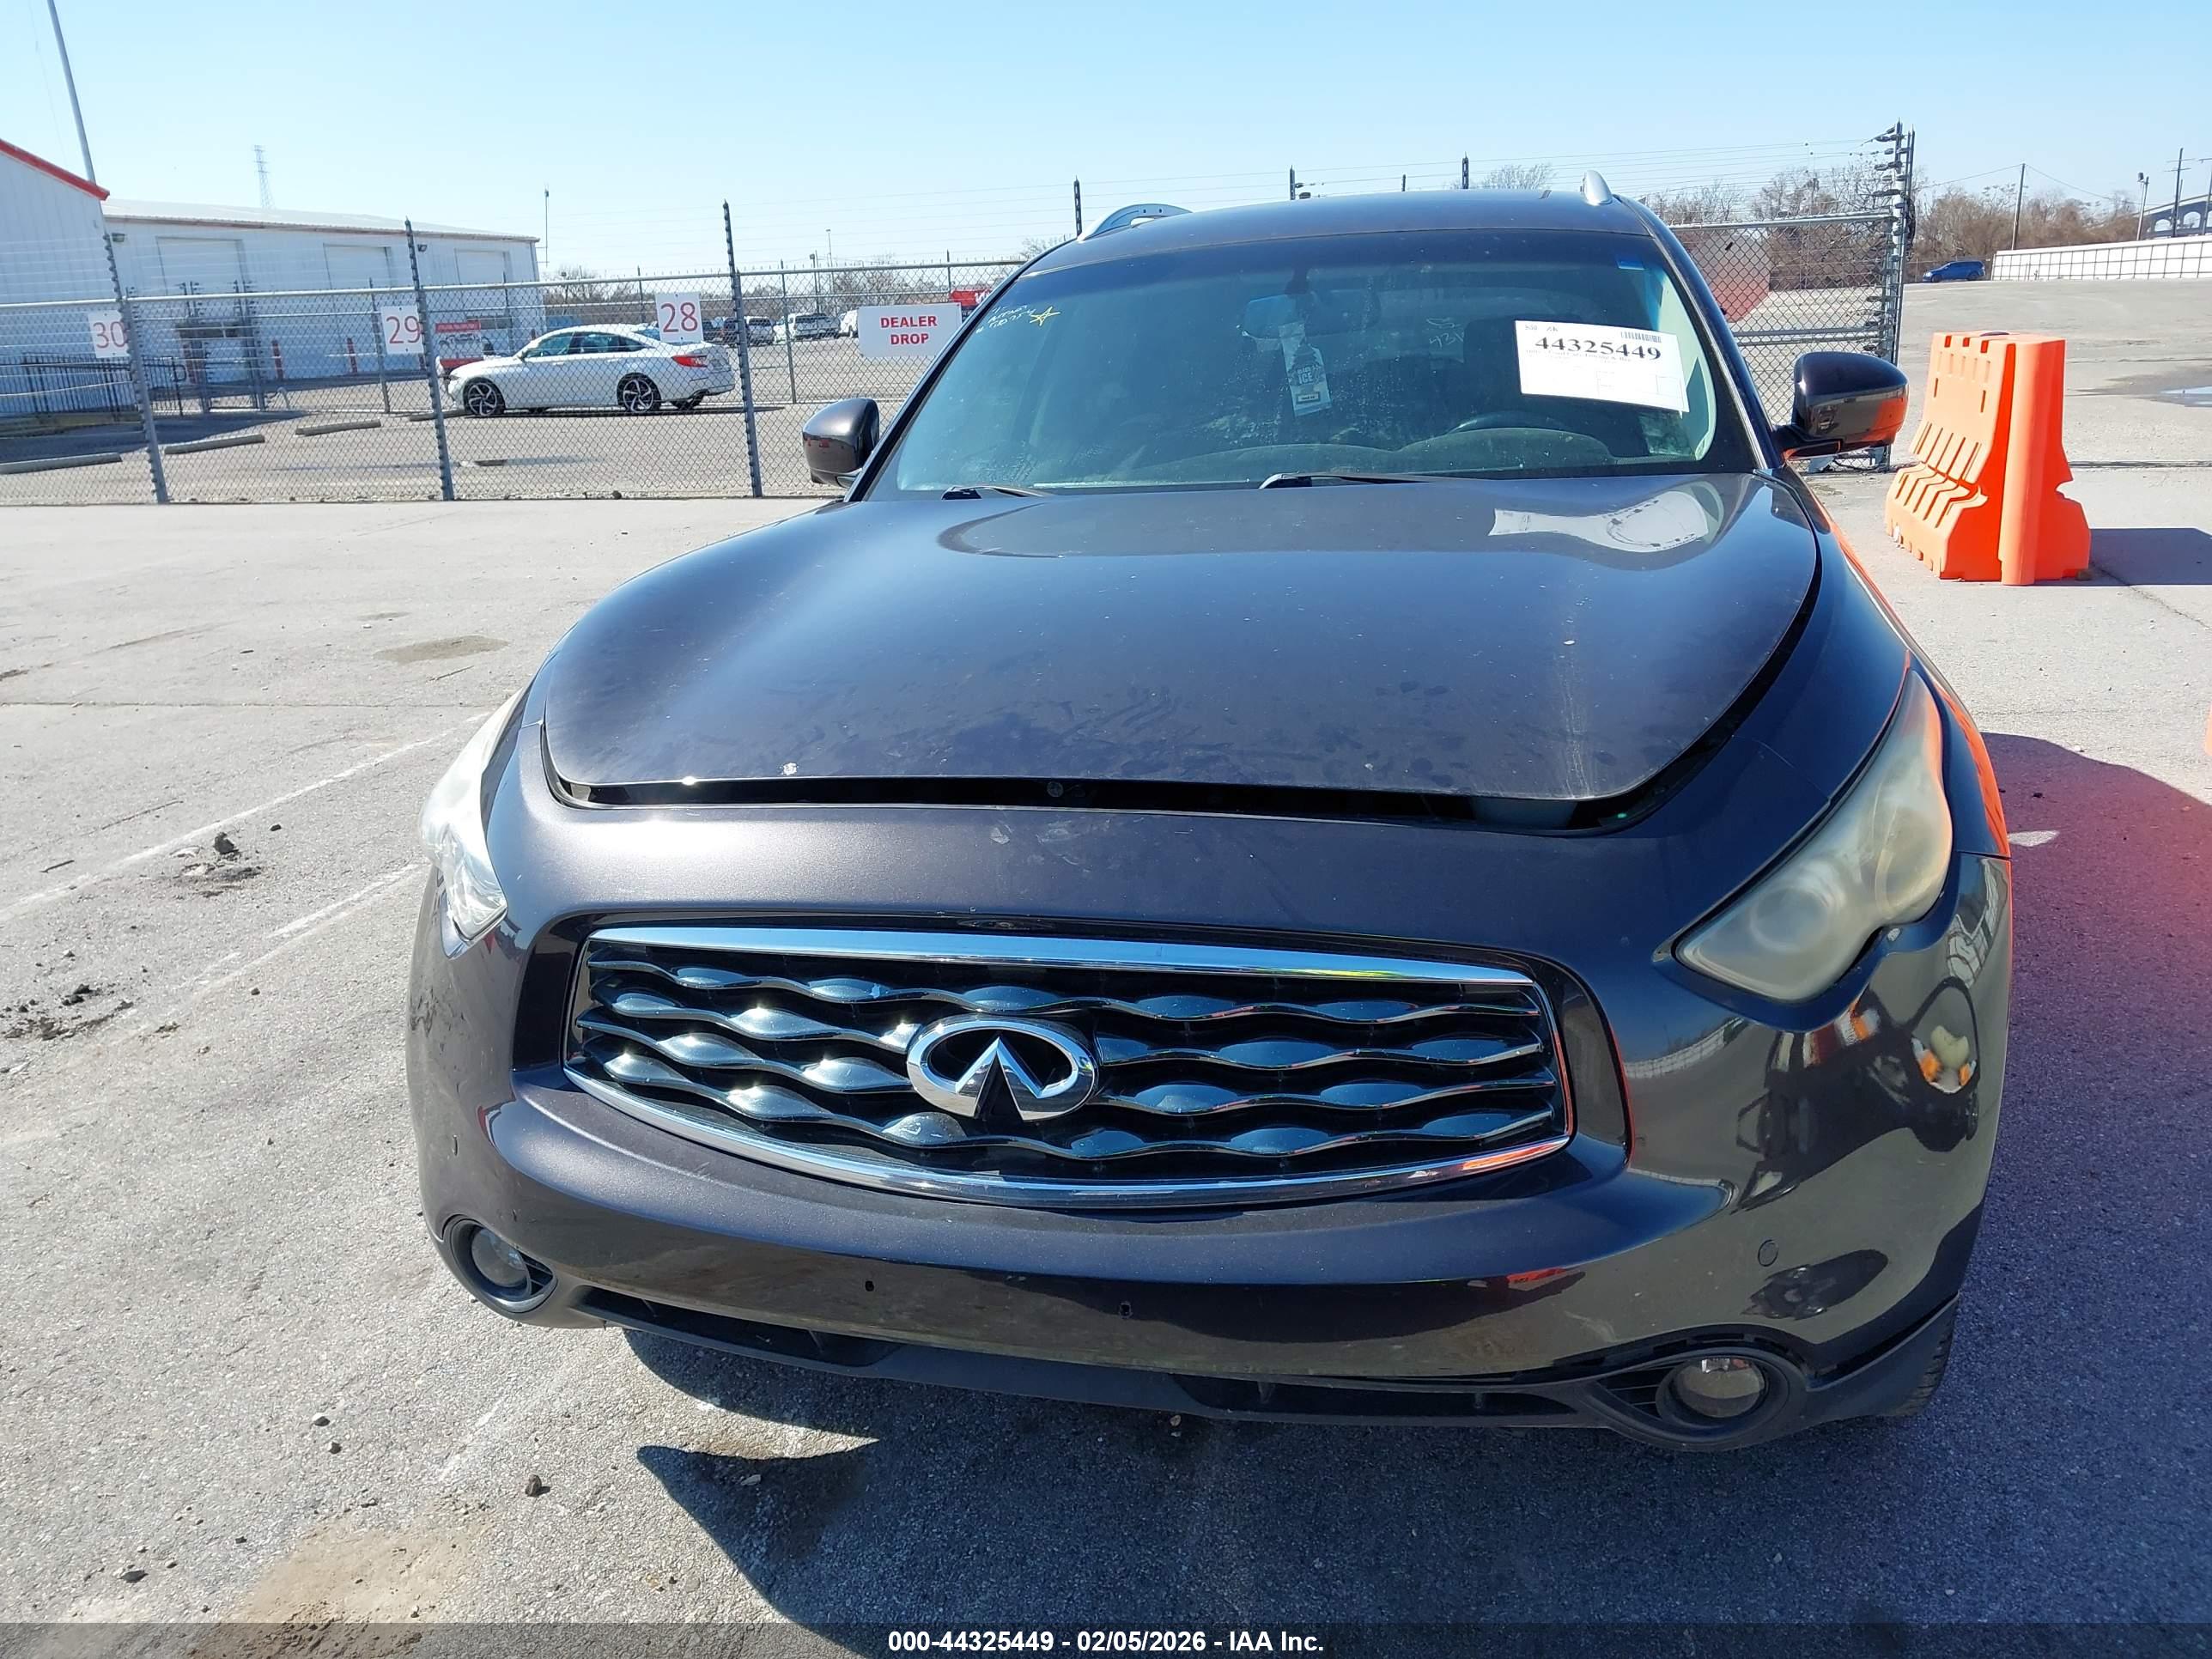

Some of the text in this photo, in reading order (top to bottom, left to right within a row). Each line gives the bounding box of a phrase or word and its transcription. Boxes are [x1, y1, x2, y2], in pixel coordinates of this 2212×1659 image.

[386, 315, 421, 344] 29
[660, 301, 698, 333] 28
[880, 315, 938, 329] DEALER
[93, 320, 126, 349] 30
[890, 332, 929, 345] DROP
[1534, 336, 1662, 361] 44325449
